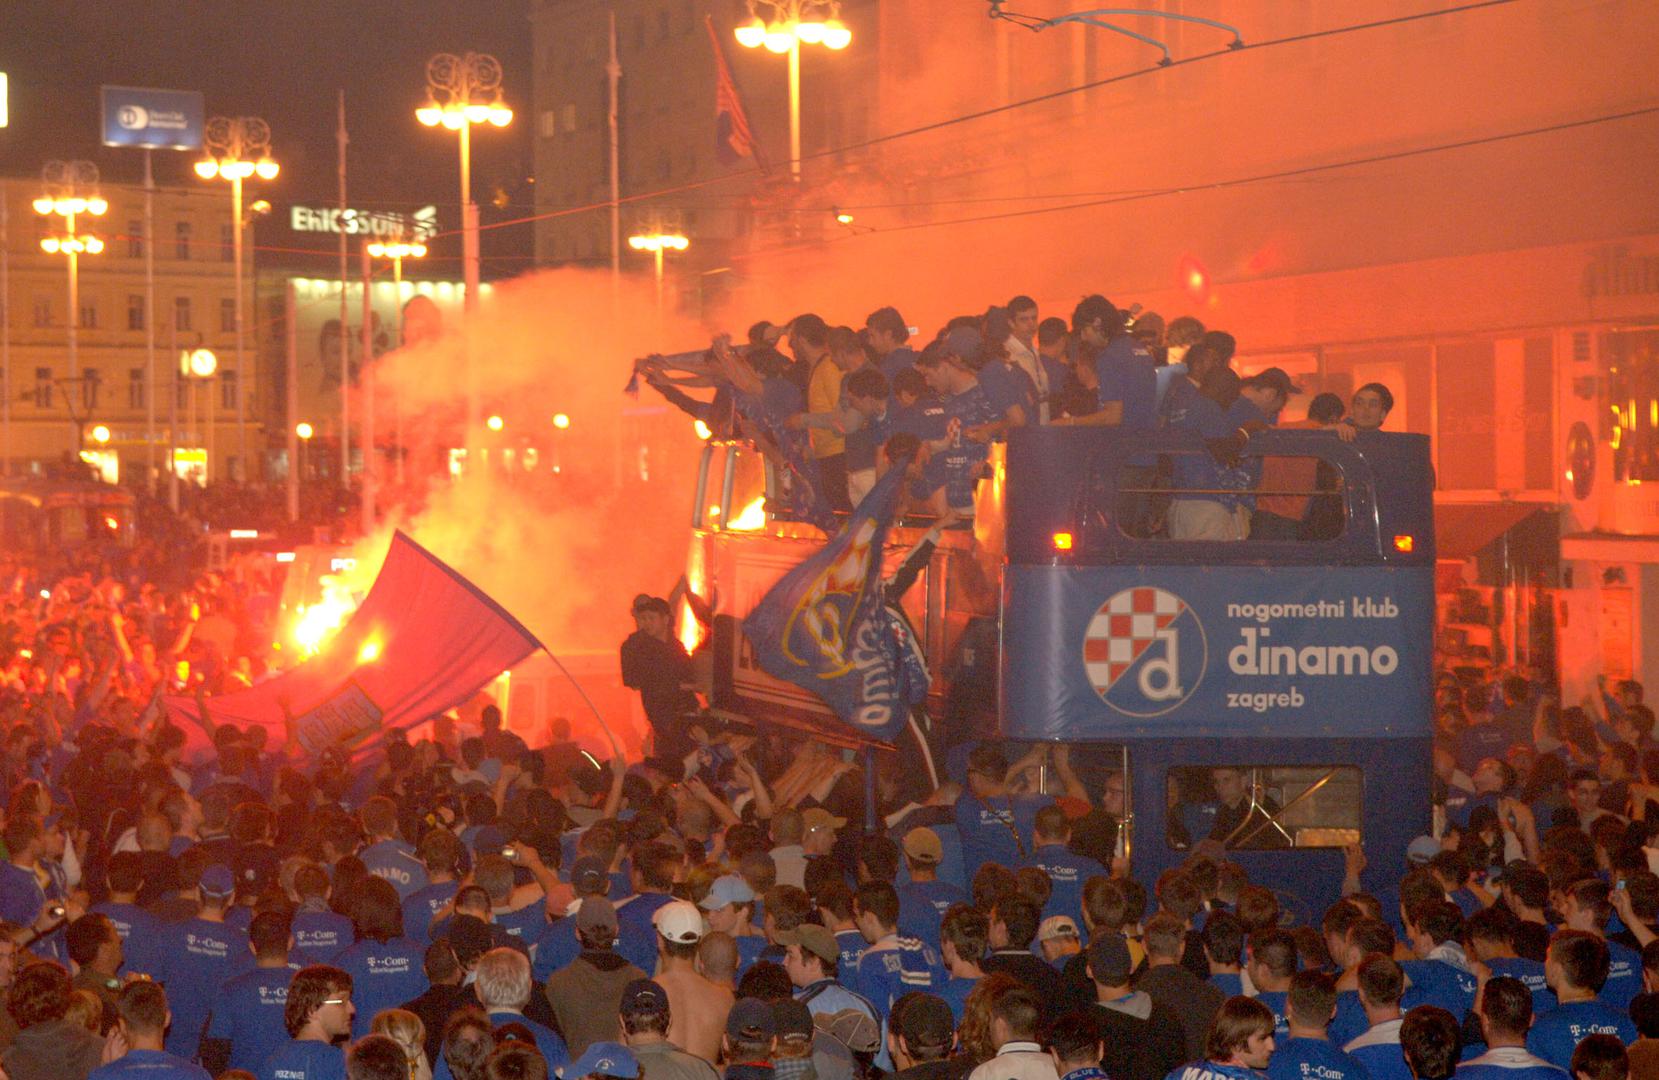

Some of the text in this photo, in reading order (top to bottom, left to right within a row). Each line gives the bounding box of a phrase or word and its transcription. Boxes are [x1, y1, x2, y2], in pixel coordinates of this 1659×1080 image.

[1228, 596, 1399, 623] nogometni klub
[1228, 627, 1399, 675] dinamo
[1227, 686, 1305, 712] zagreb
